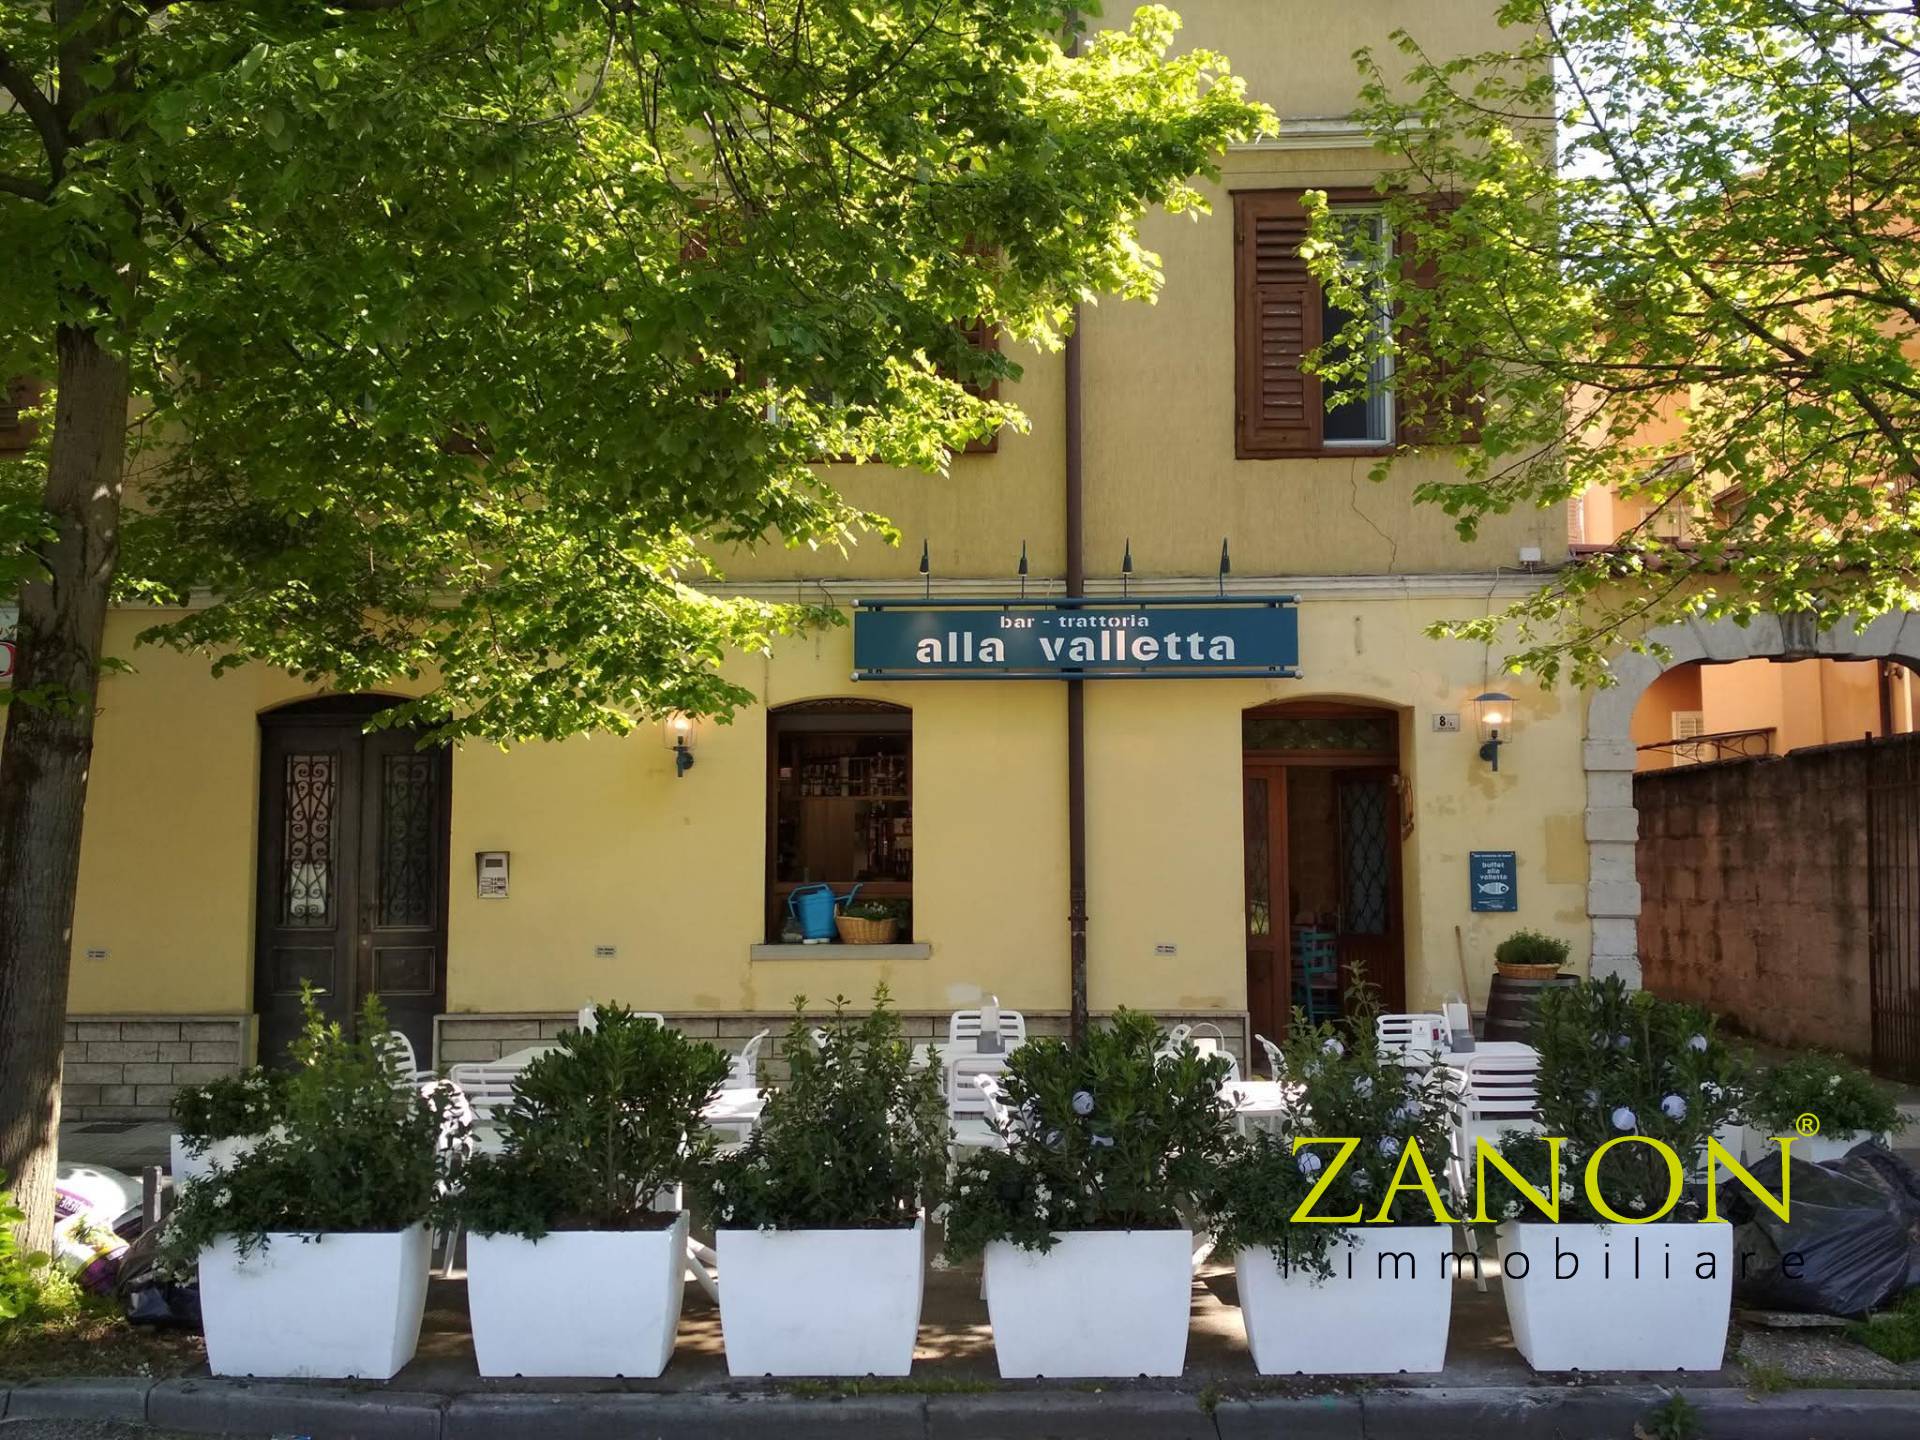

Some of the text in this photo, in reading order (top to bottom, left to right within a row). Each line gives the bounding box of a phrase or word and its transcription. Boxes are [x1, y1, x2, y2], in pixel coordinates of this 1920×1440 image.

[1000, 615, 1035, 629] bar
[1059, 615, 1149, 628] trattoria
[916, 630, 1236, 663] alla valletta
